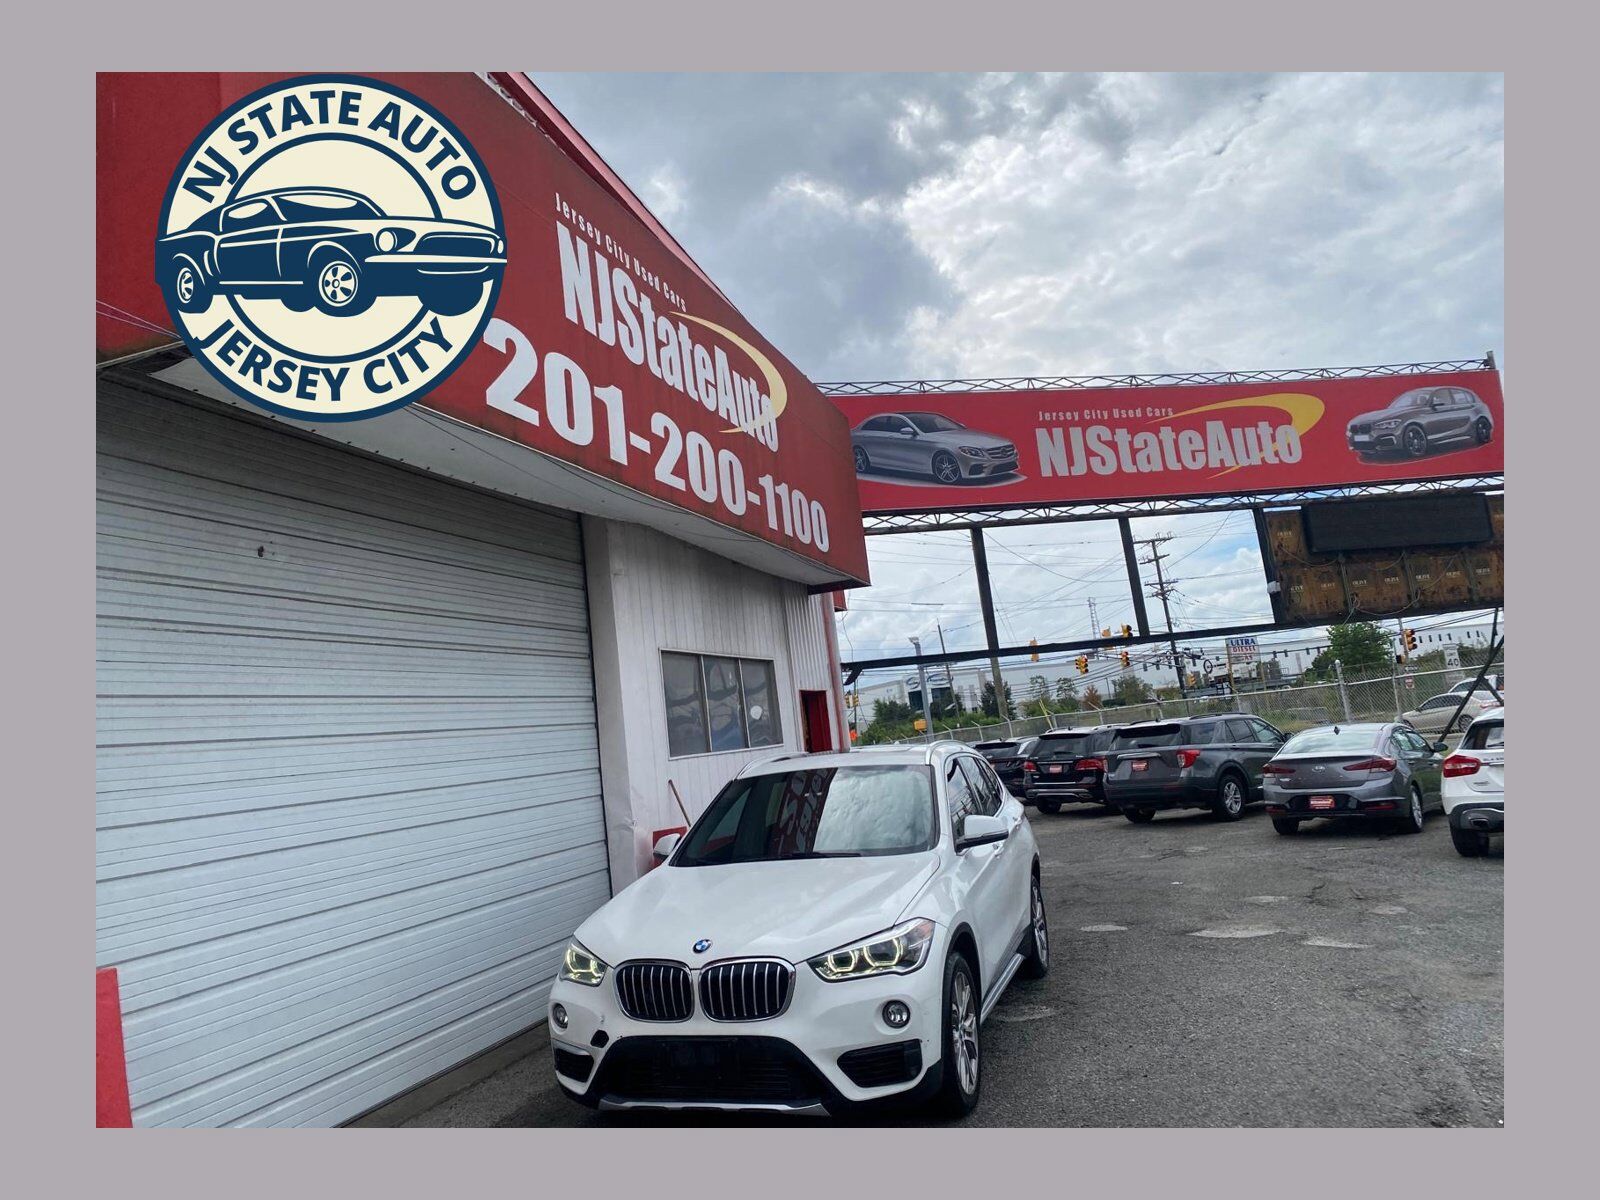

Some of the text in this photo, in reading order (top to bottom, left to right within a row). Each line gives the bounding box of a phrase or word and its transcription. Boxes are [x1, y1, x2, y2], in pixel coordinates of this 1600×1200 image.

[555, 192, 687, 313] Jersey City Used Cars
[556, 221, 779, 453] NJStateAuto
[1038, 406, 1174, 422] Jersey City Used Cars
[483, 317, 830, 553] 201-200-1100
[1035, 420, 1303, 477] NJStateAuto
[1230, 638, 1256, 646] ULTRA
[1232, 645, 1256, 653] DIESEL
[1447, 658, 1460, 667] 40
